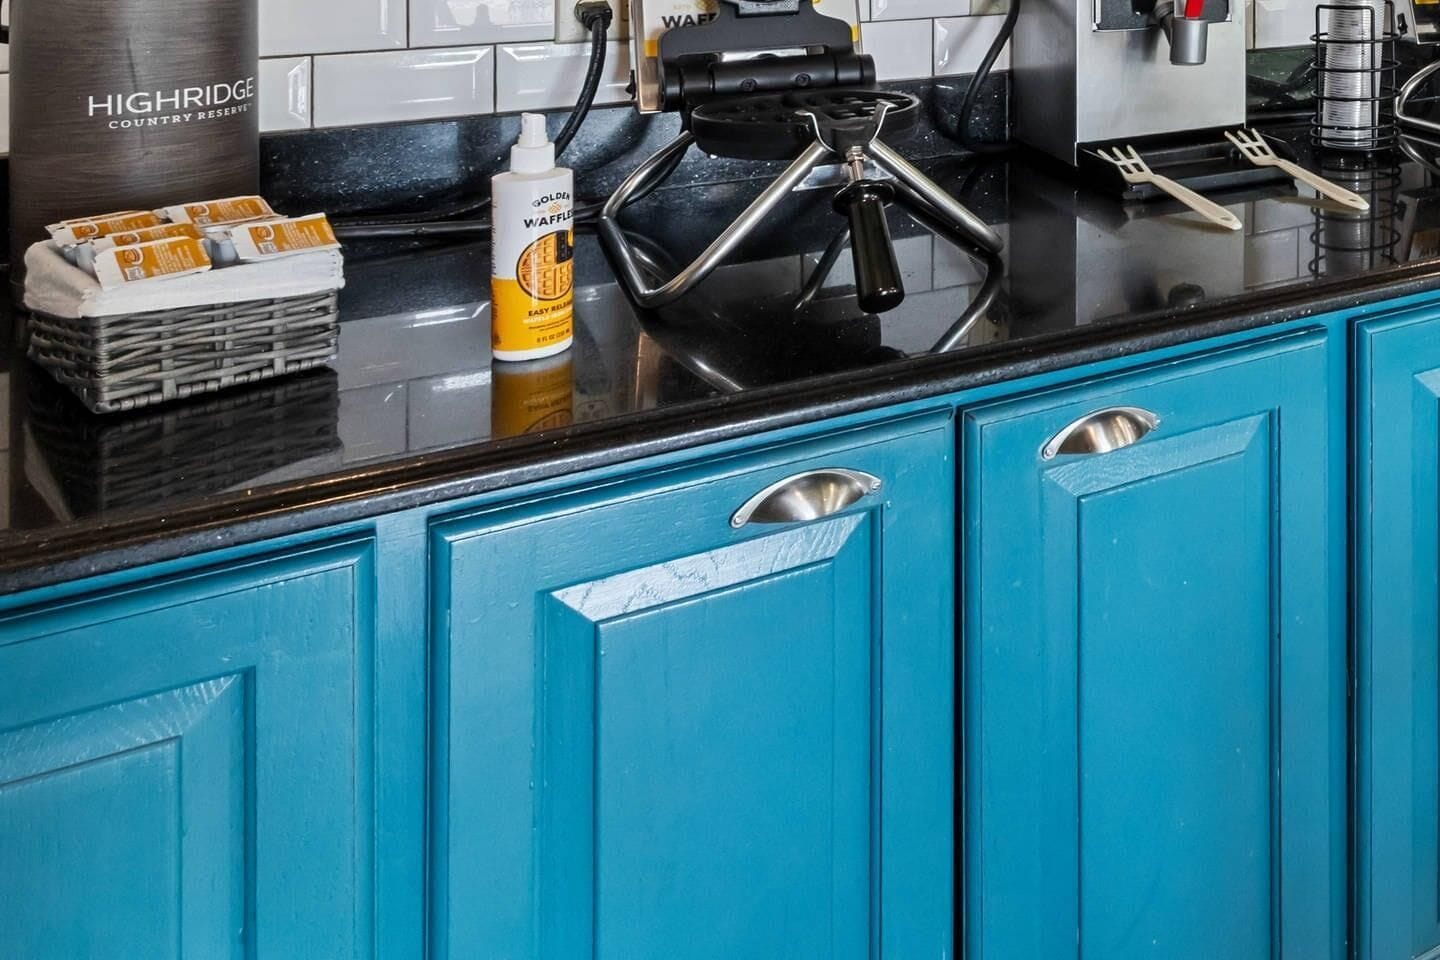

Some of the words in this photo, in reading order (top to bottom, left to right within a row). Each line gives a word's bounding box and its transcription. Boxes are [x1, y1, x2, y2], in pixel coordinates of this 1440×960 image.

[88, 77, 255, 117] HIGHRIDGE
[108, 113, 192, 129] COUNTRY
[532, 192, 570, 207] GOLDEN
[528, 307, 550, 317] EASY
